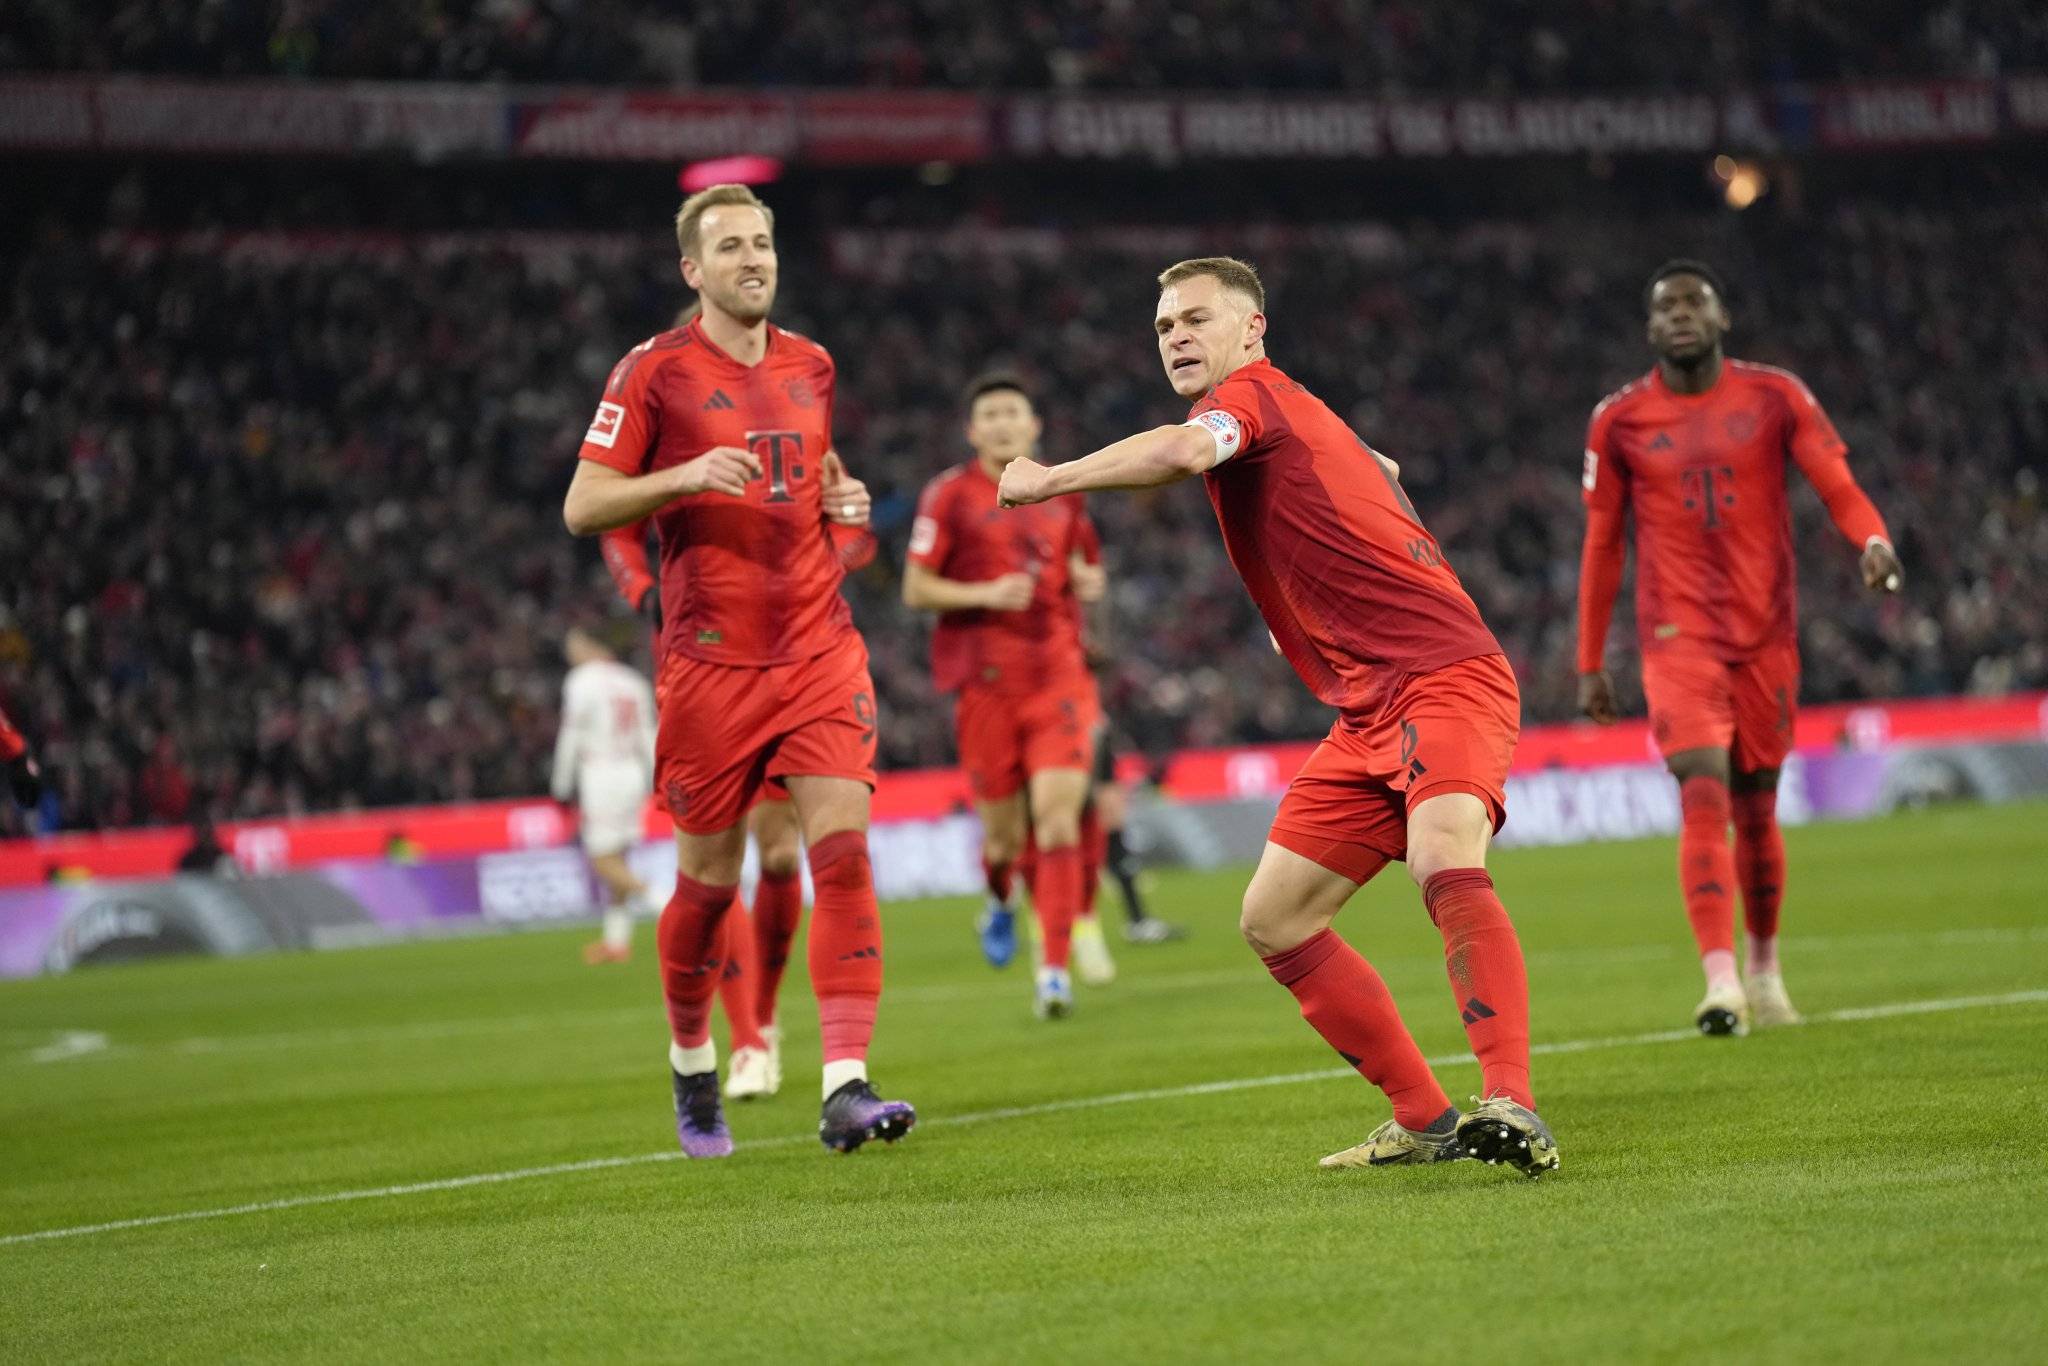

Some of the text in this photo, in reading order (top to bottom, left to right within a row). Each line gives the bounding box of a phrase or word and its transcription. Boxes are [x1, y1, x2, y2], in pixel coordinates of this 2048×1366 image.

[1055, 99, 1172, 157] GUTE
[1184, 98, 1380, 153] FREUNDE
[852, 692, 877, 744] 9
